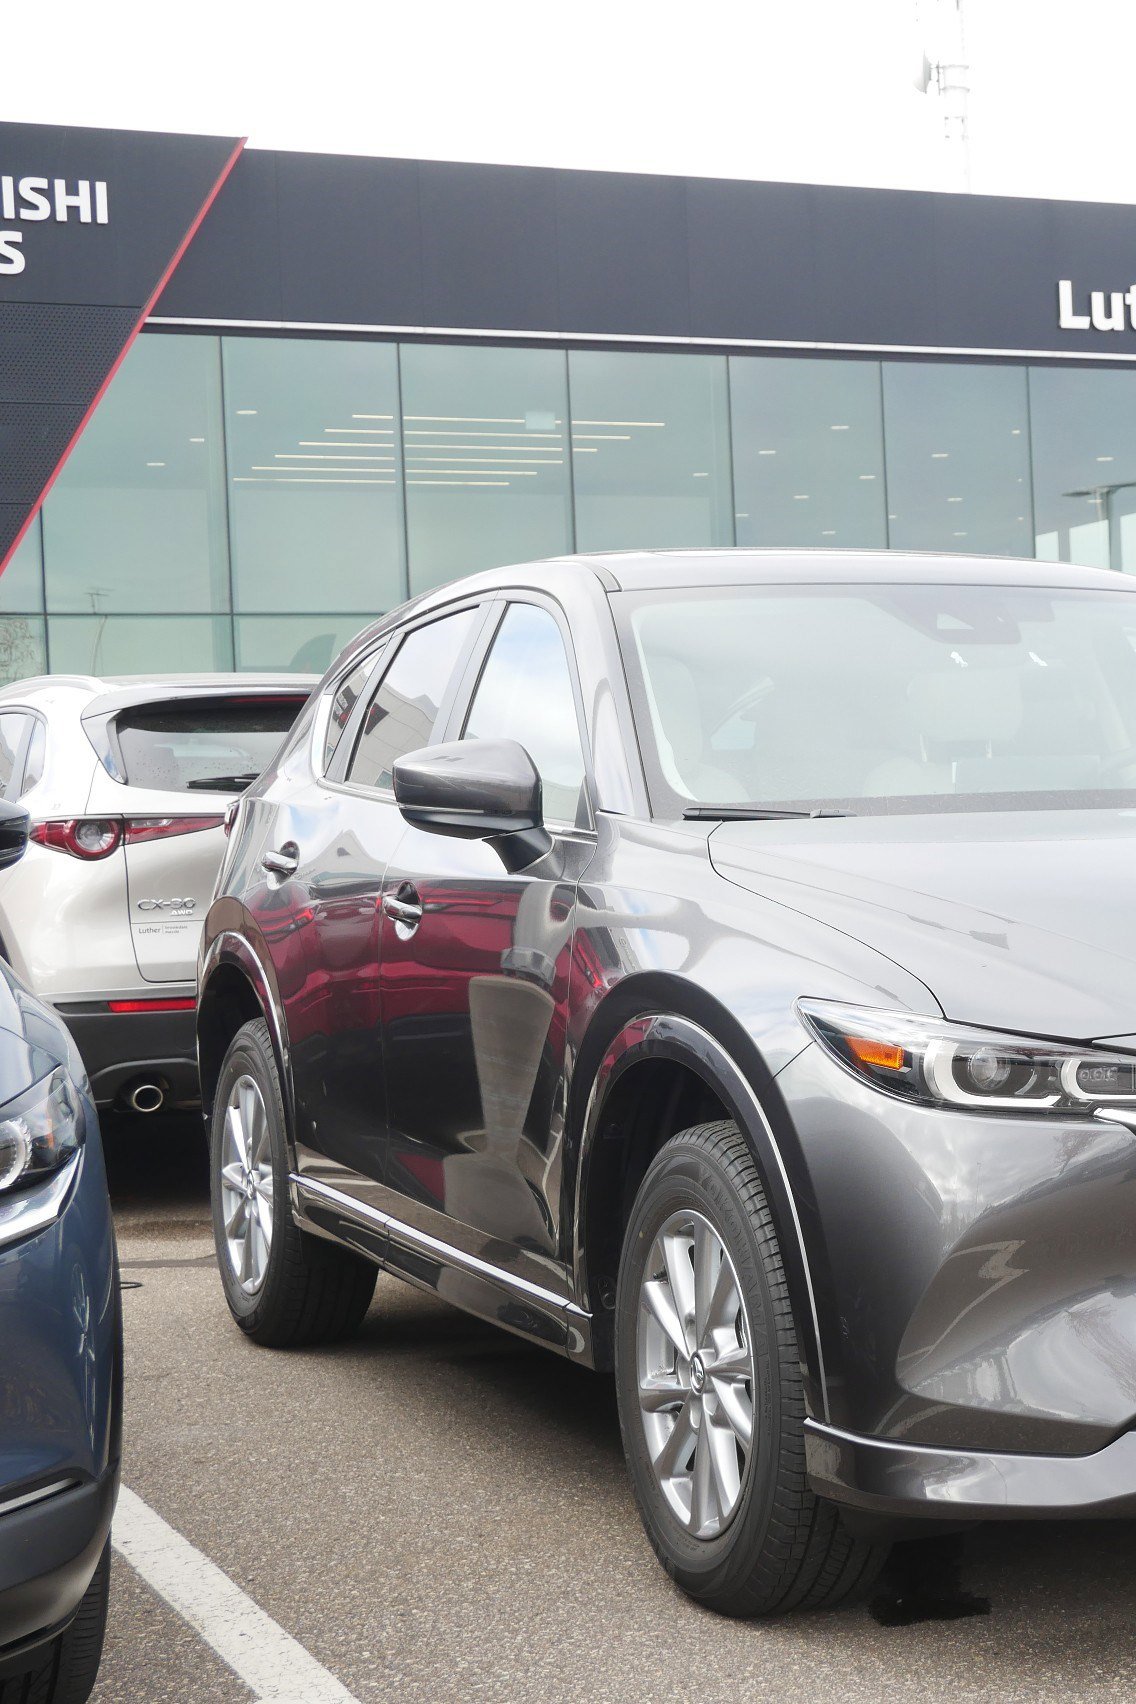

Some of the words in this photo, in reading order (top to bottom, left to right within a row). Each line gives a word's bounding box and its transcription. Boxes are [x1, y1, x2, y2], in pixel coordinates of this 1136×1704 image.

[1, 175, 109, 224] ISHI
[0, 230, 25, 274] S
[137, 897, 196, 910] CX-30
